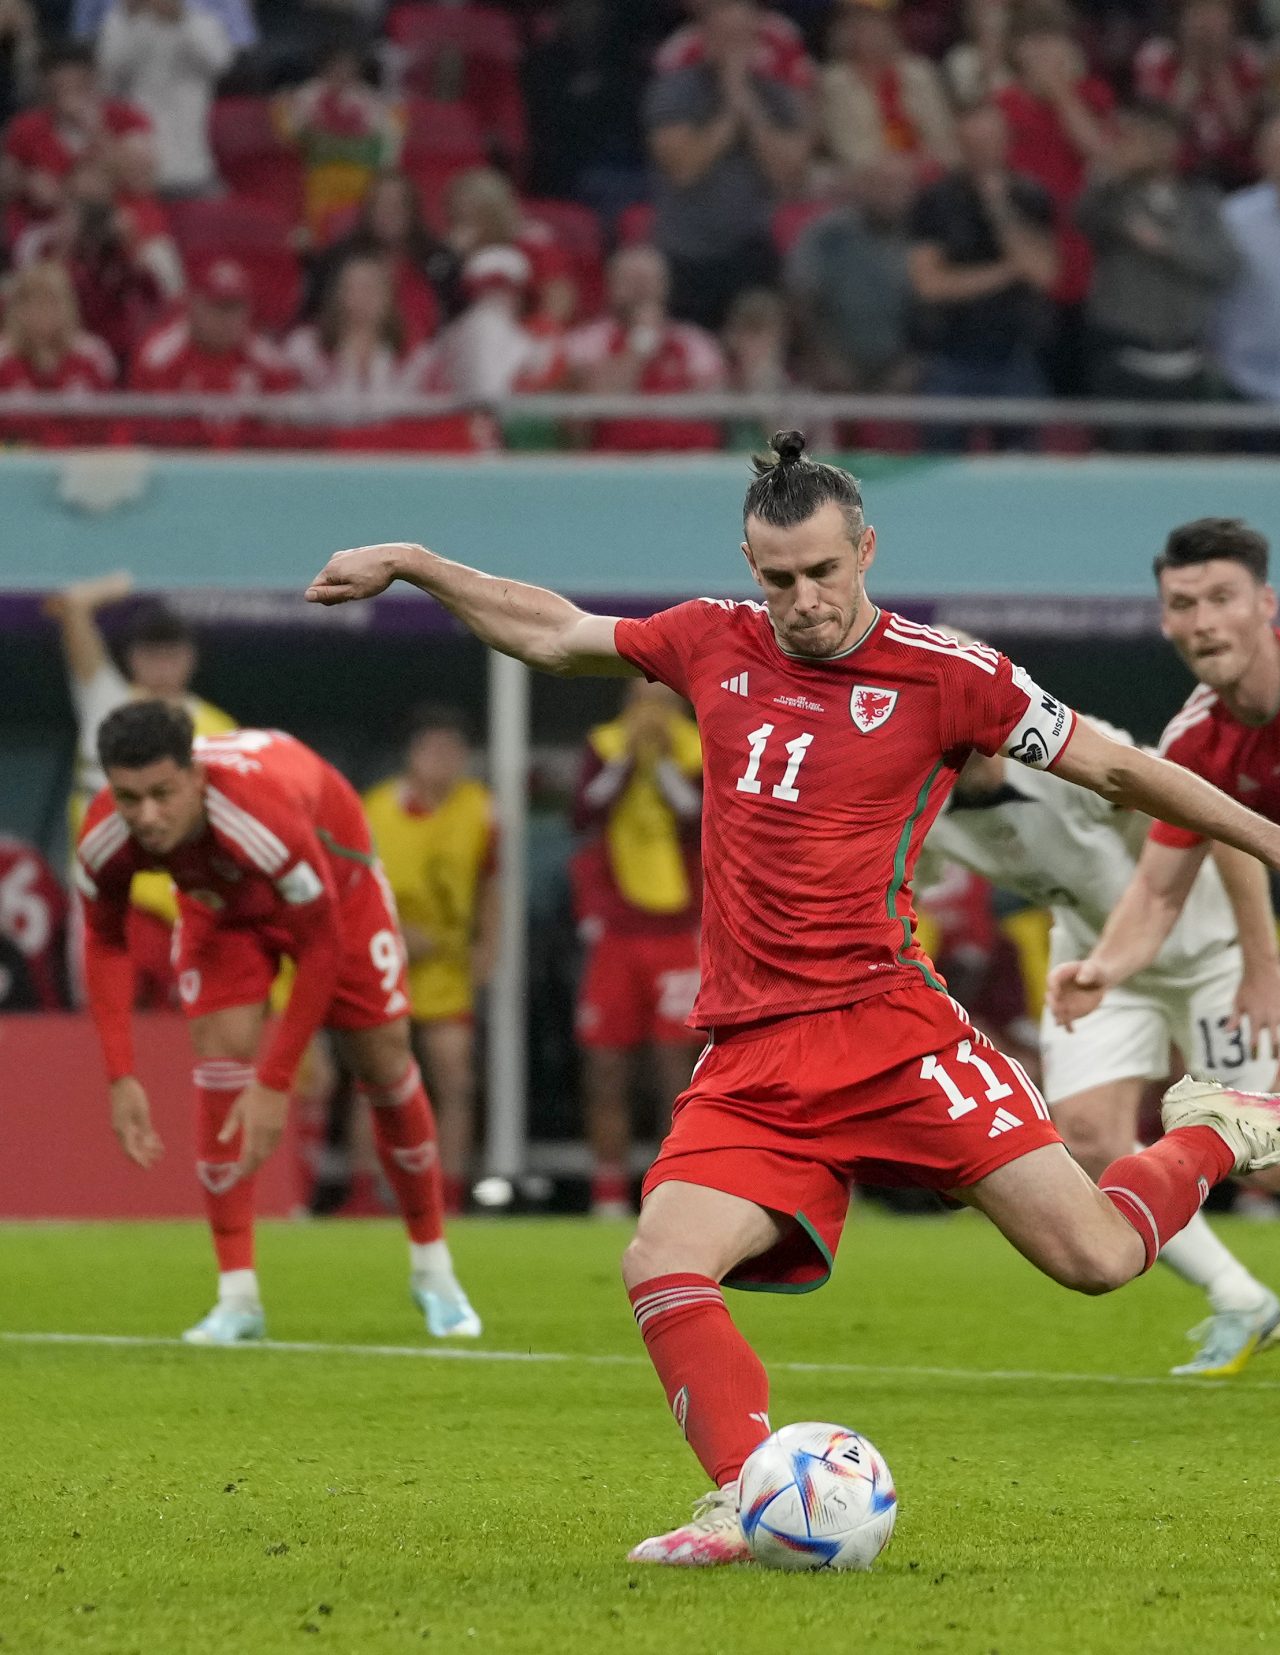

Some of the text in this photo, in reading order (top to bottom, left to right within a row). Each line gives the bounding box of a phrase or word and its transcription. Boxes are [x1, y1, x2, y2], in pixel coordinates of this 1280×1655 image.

[1041, 693, 1058, 716] N
[736, 723, 814, 802] 11
[369, 930, 400, 992] 9
[1198, 1016, 1245, 1069] 13
[919, 1039, 1013, 1120] 11
